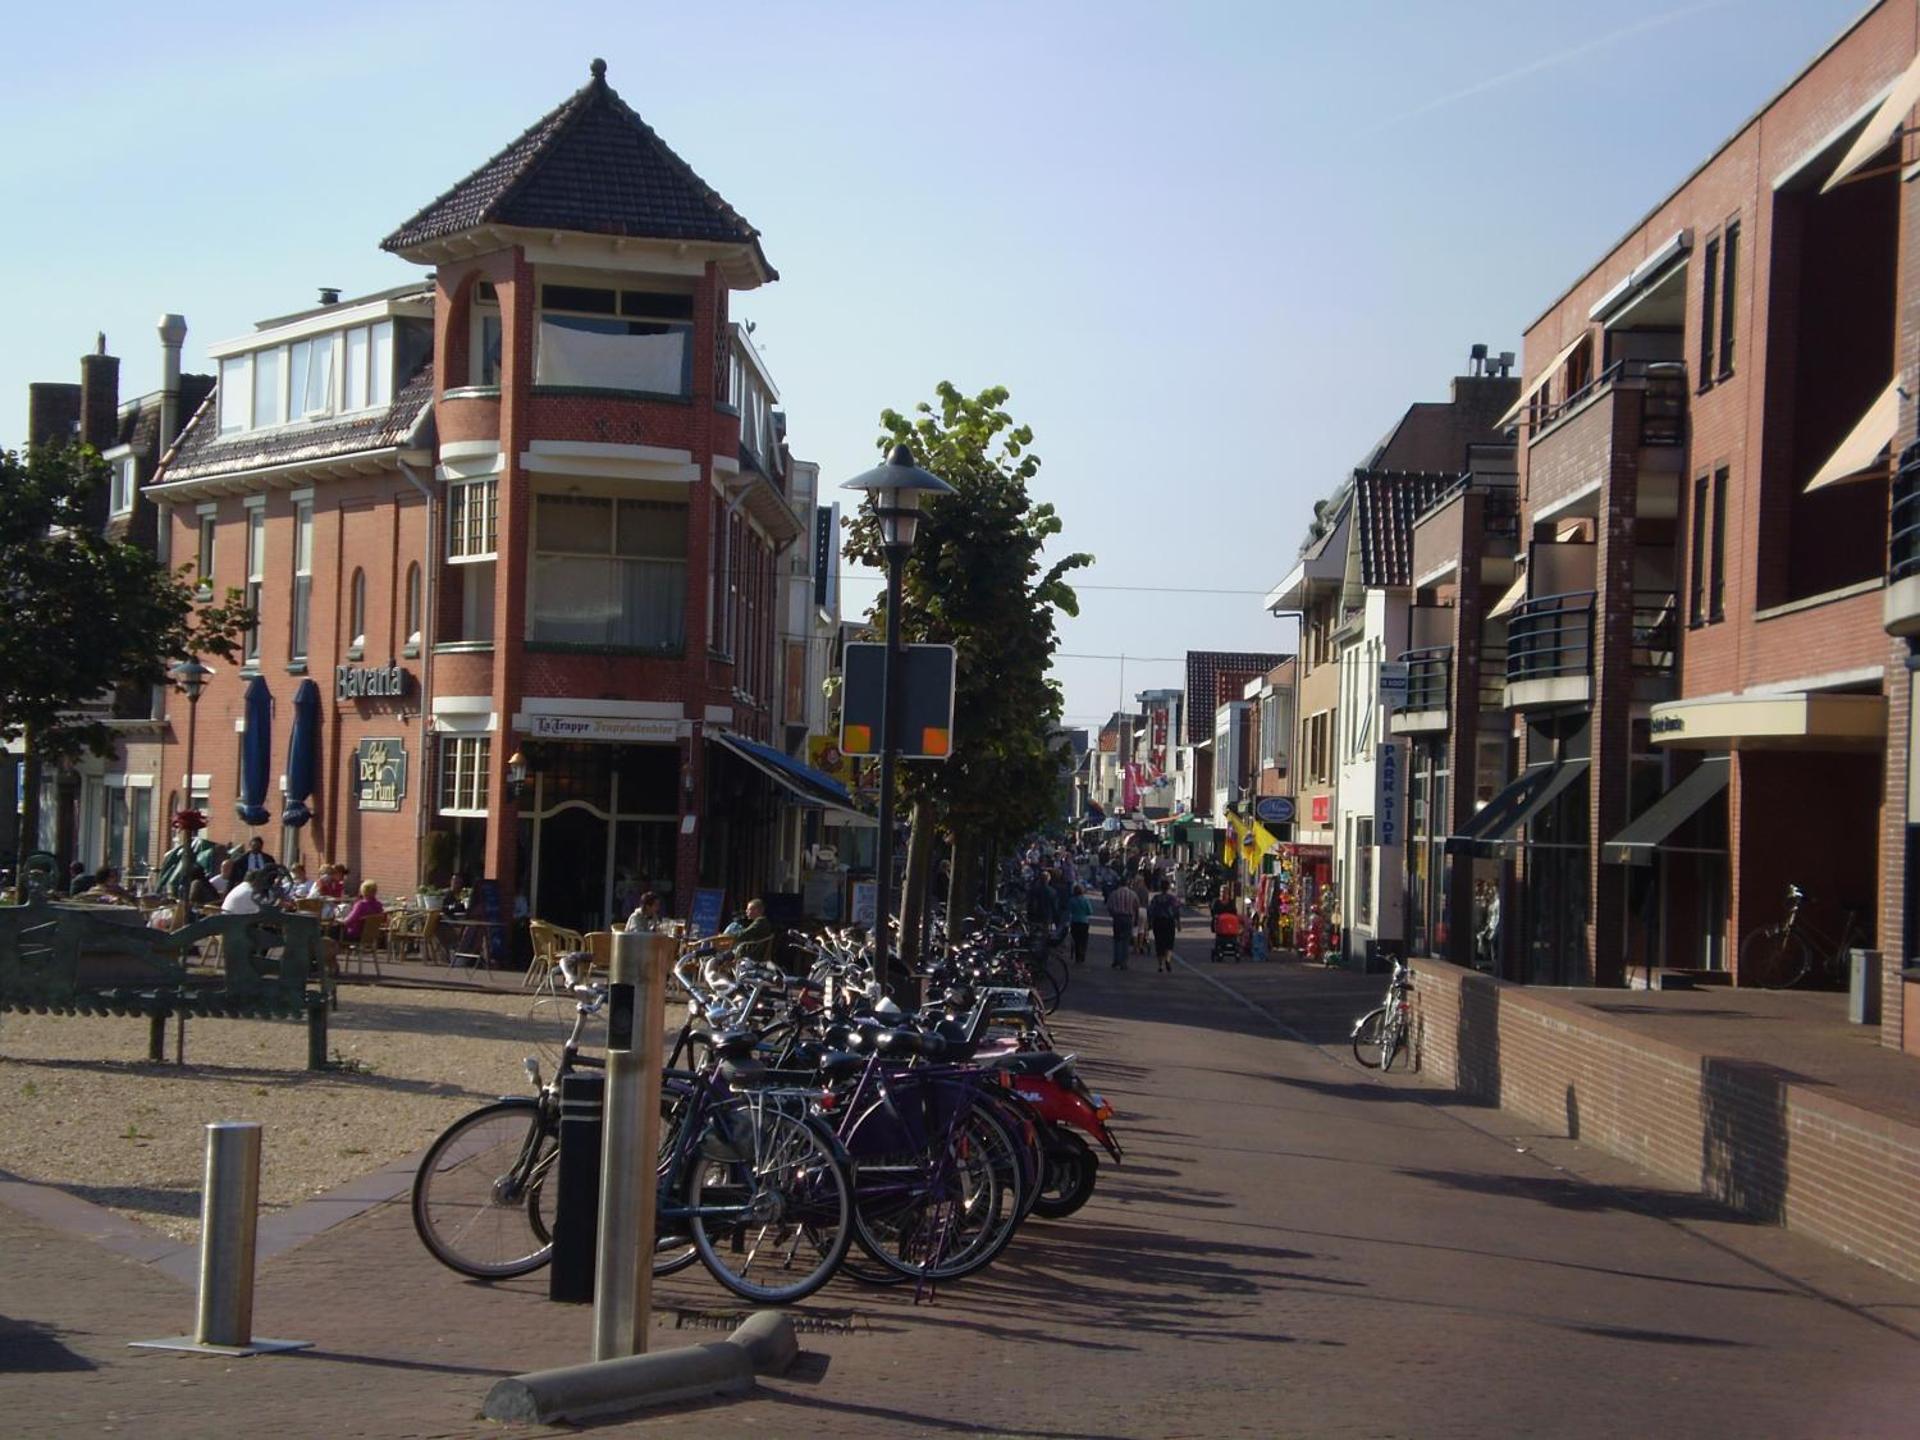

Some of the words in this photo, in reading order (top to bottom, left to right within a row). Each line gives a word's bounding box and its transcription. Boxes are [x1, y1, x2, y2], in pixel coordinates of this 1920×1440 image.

[336, 665, 402, 700] Bavaria
[551, 718, 590, 734] Trappe
[360, 762, 375, 781] De
[1383, 744, 1395, 792] PARK
[374, 781, 396, 801] Punt
[1382, 796, 1394, 845] SIDE
